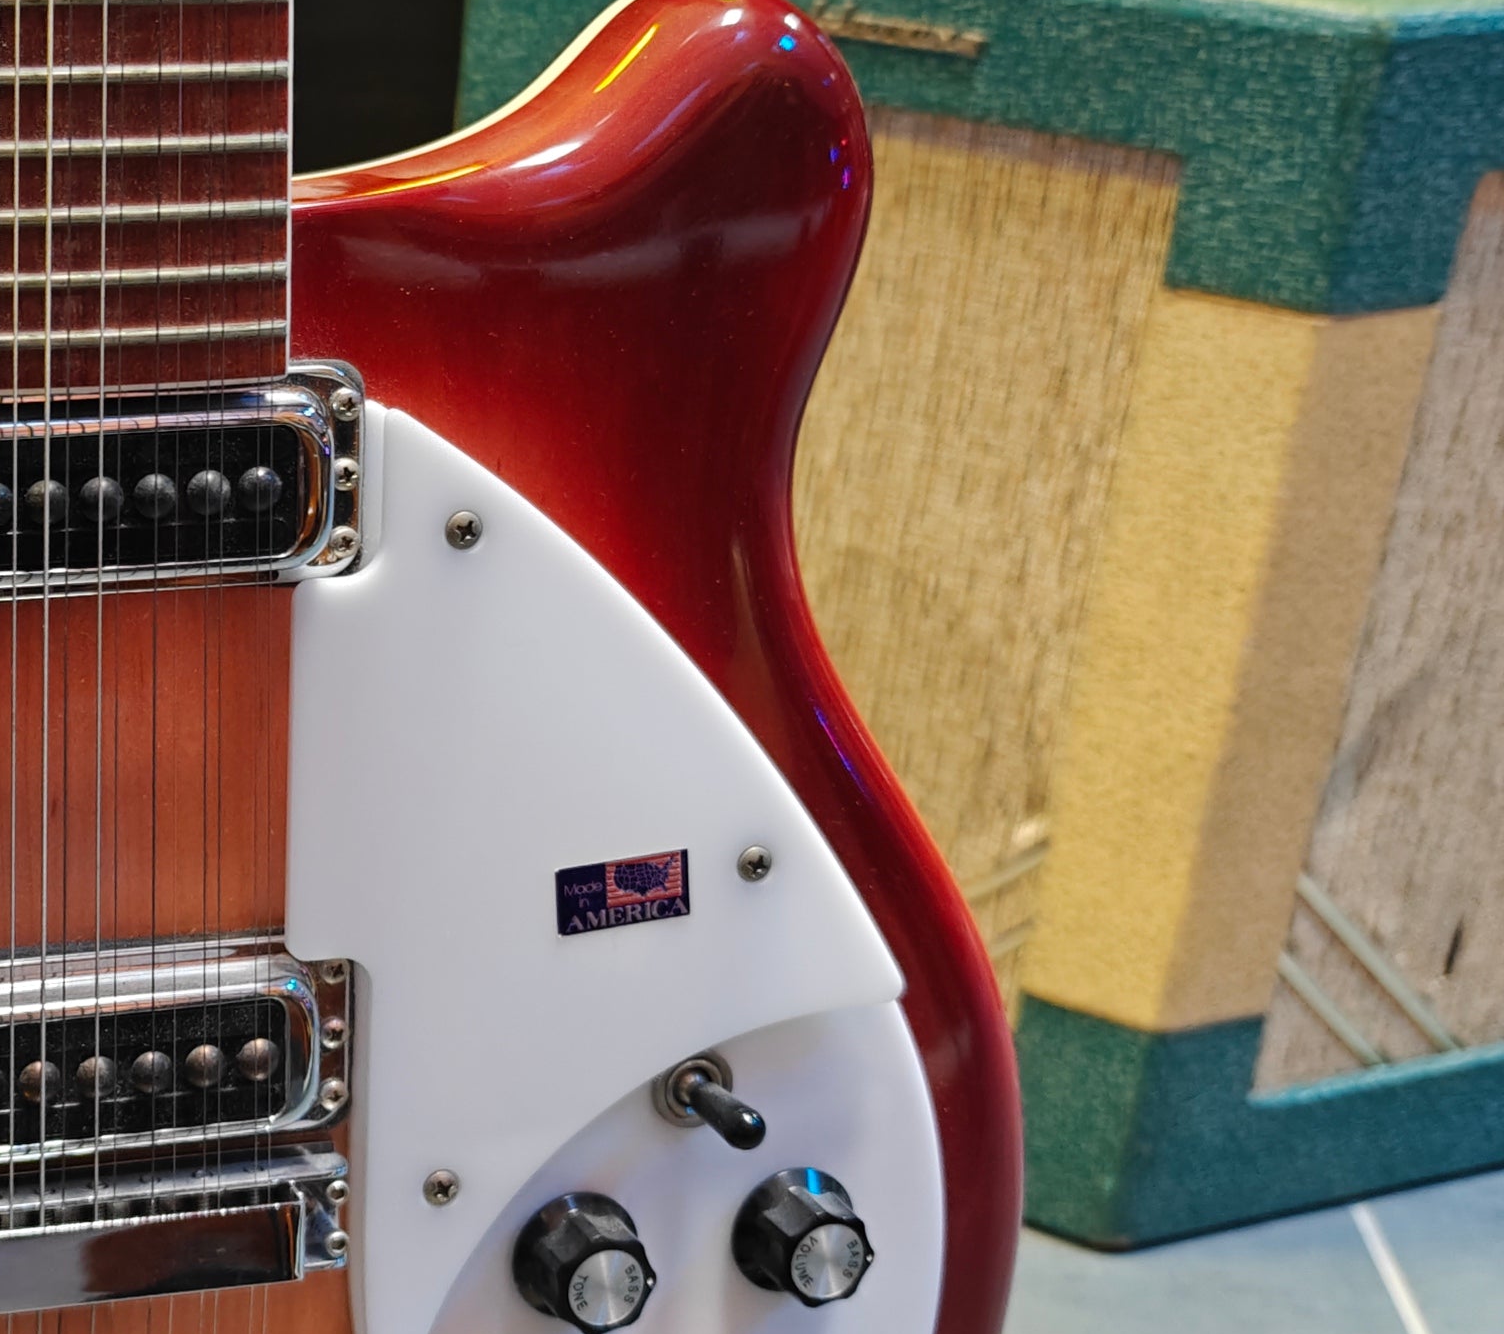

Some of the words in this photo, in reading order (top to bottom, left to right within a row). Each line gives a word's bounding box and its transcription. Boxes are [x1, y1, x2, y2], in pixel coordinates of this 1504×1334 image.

[564, 881, 602, 896] Made
[578, 896, 590, 908] in
[565, 897, 688, 933] AMERICA
[794, 1235, 819, 1288] VOLUME
[846, 1239, 860, 1280] BASS
[572, 1274, 589, 1312] TONE
[624, 1263, 639, 1305] BASS
